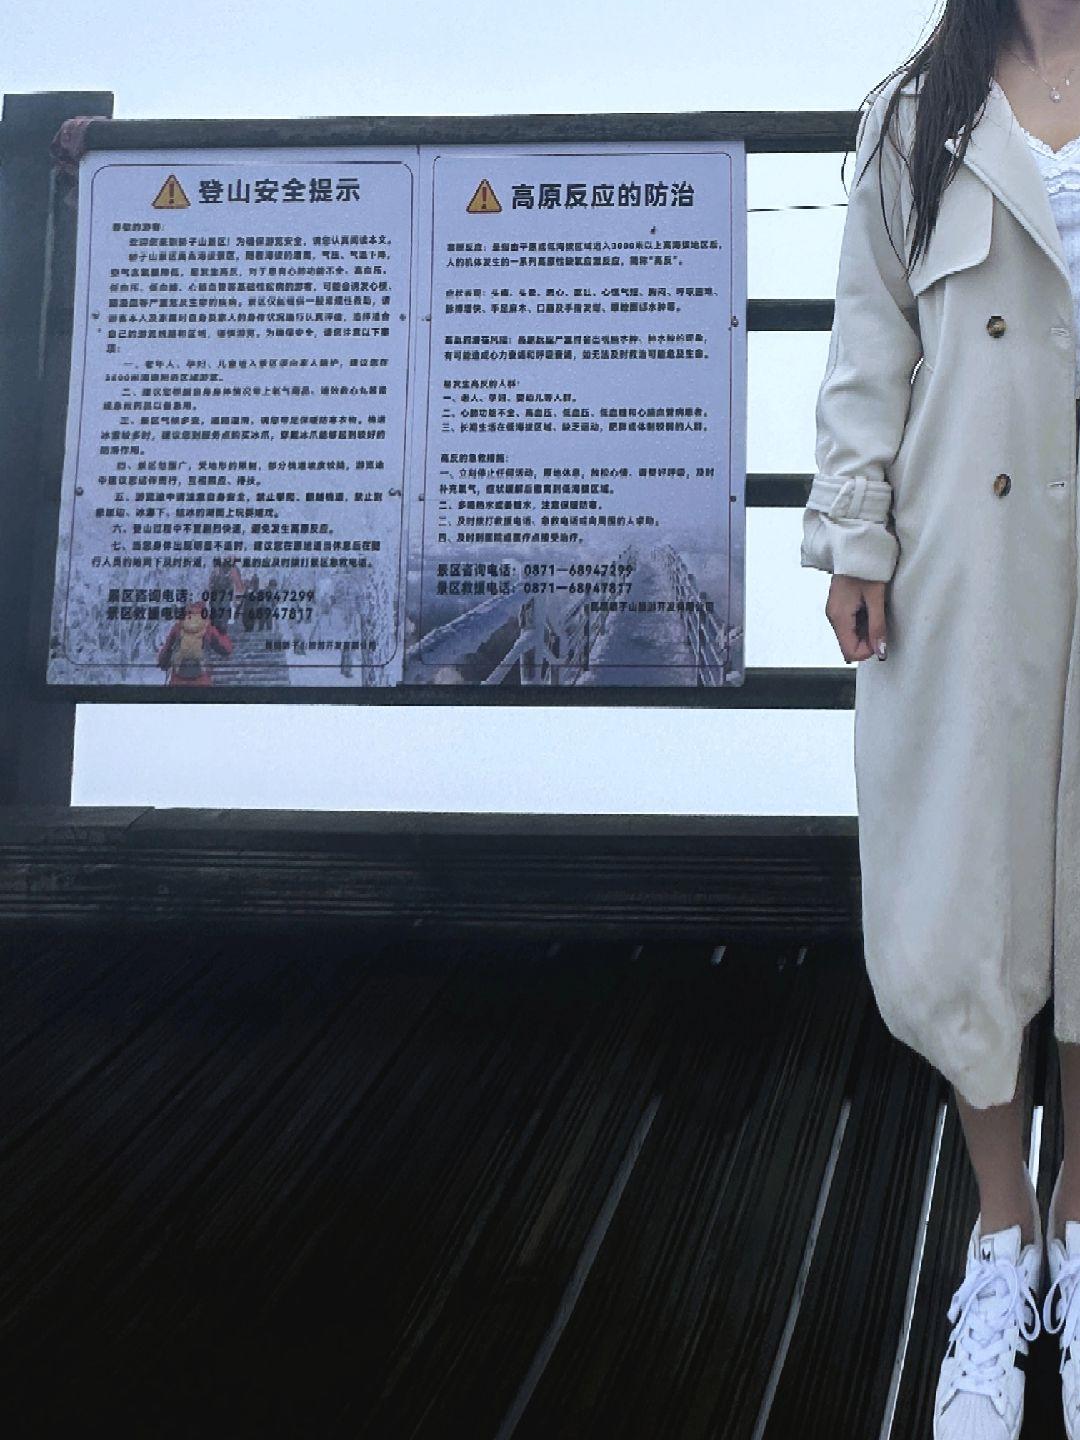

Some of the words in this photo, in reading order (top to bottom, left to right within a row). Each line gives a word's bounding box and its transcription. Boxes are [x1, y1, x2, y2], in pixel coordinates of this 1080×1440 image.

[199, 178, 361, 204] 登山安全提示
[511, 182, 694, 209] 高原反应的防治
